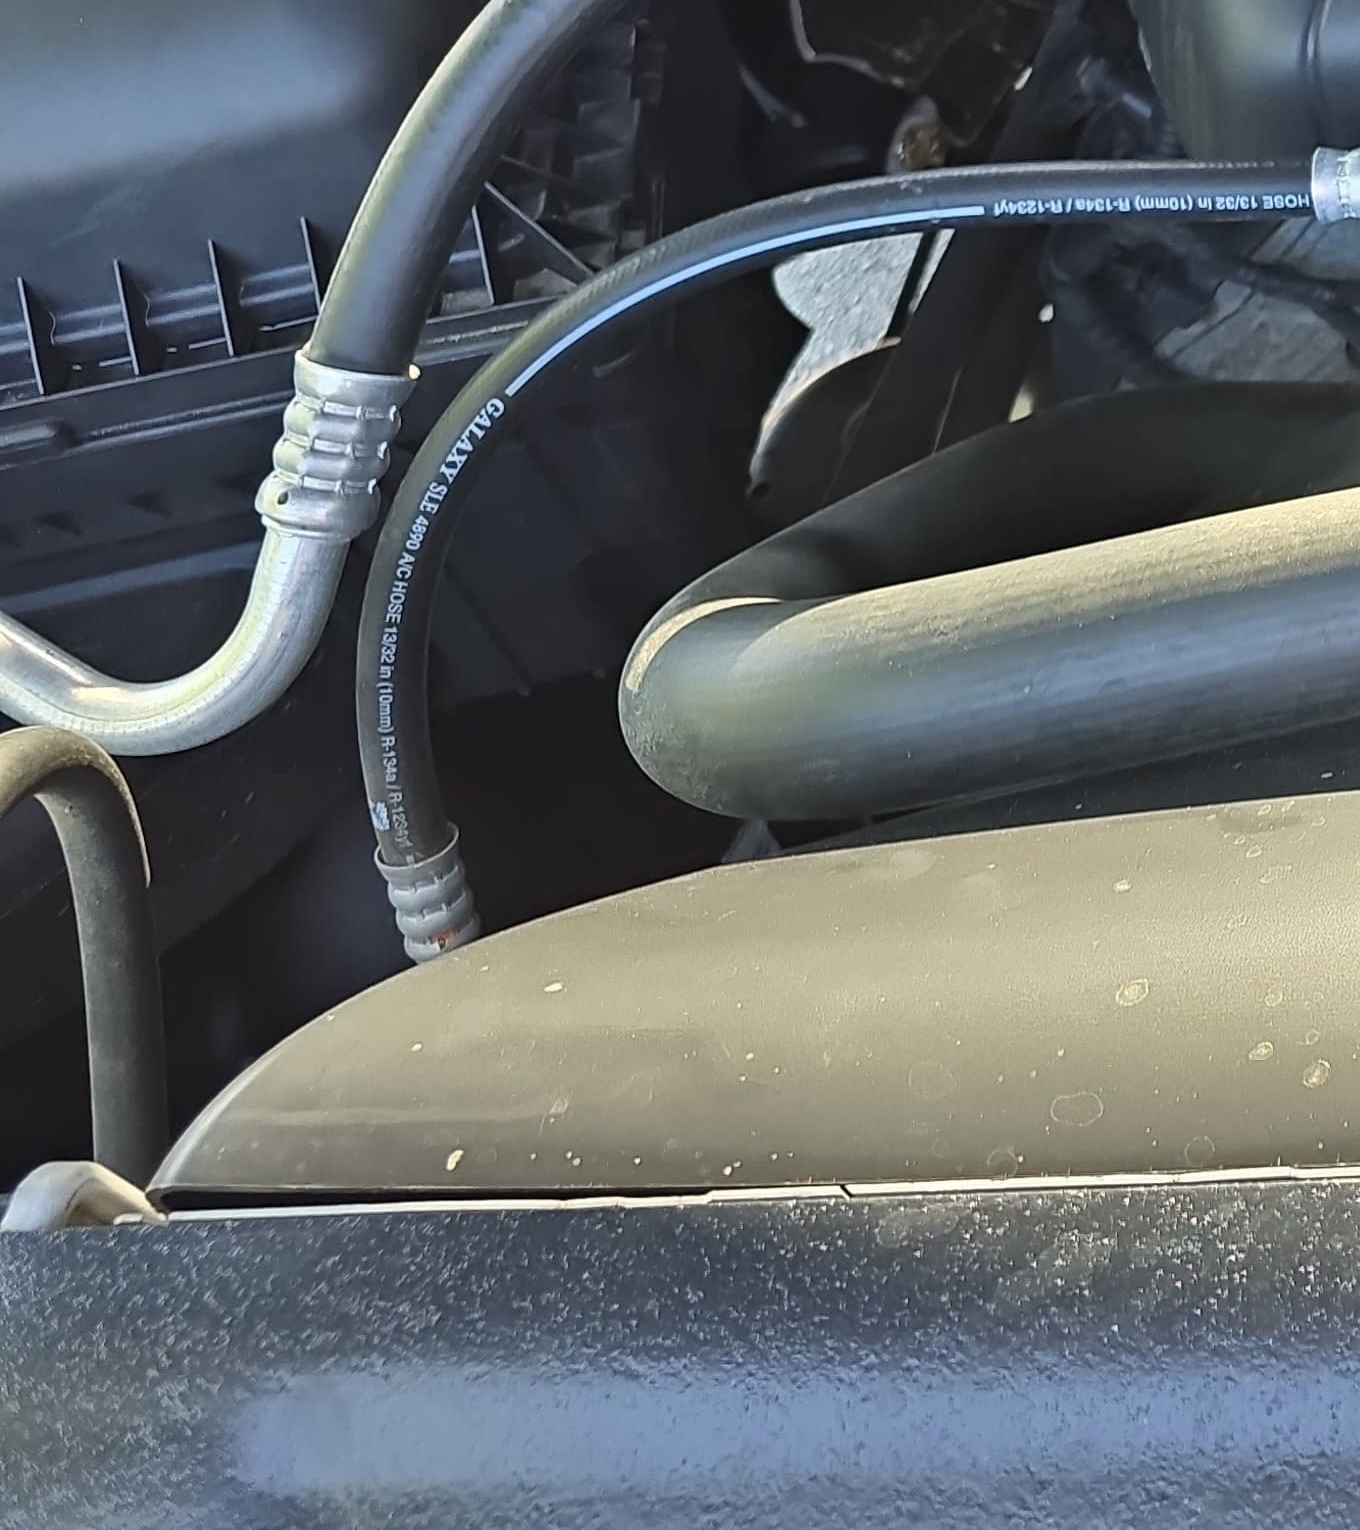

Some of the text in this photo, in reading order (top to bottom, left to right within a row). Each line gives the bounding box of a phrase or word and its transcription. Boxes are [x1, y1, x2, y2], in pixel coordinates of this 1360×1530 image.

[993, 197, 1064, 218] R-1234yf
[1074, 196, 1131, 212] R-134a
[1134, 195, 1194, 213] (10mm)
[1215, 194, 1259, 213] 13/32
[1263, 193, 1311, 210] HOSE
[439, 397, 506, 484] GALAXY
[419, 481, 449, 515] SLE
[405, 514, 430, 552] 4890
[395, 551, 416, 581] A/C
[385, 581, 409, 624] HOSE
[380, 626, 399, 664] 13/32
[379, 664, 395, 679] in
[376, 680, 395, 734] (10mm)
